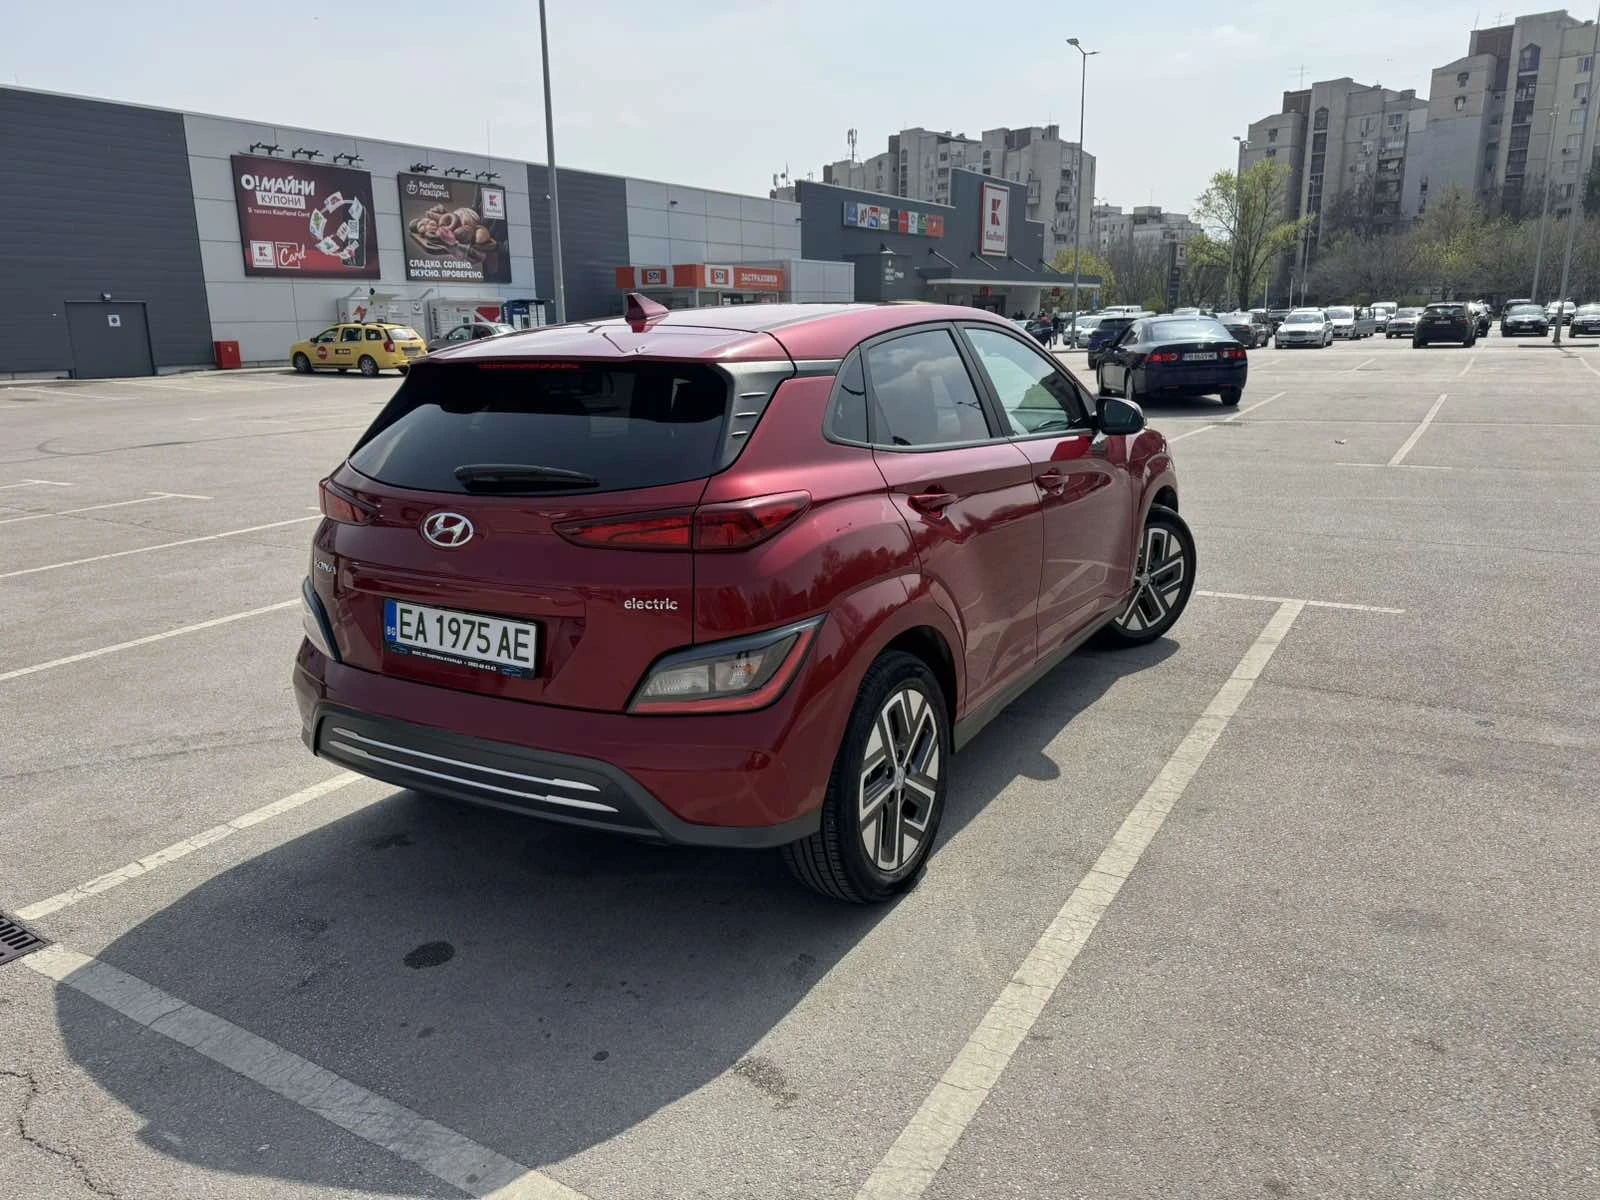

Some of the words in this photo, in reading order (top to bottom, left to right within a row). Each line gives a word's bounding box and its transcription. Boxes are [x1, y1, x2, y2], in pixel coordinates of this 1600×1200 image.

[241, 174, 316, 197] О!МАЙНИ
[261, 193, 303, 206] КУПОНИ
[280, 243, 307, 266] Card
[409, 260, 442, 269] СЛАДКО.
[443, 261, 473, 270] СОЛЕНО.
[410, 269, 441, 278] ВКУСНО.
[442, 270, 484, 279] ПРОВЕРЕНО.
[624, 597, 678, 610] electric
[387, 626, 396, 636] BG
[399, 607, 428, 643] EA
[436, 614, 491, 654] 1975
[496, 625, 531, 662] AE
